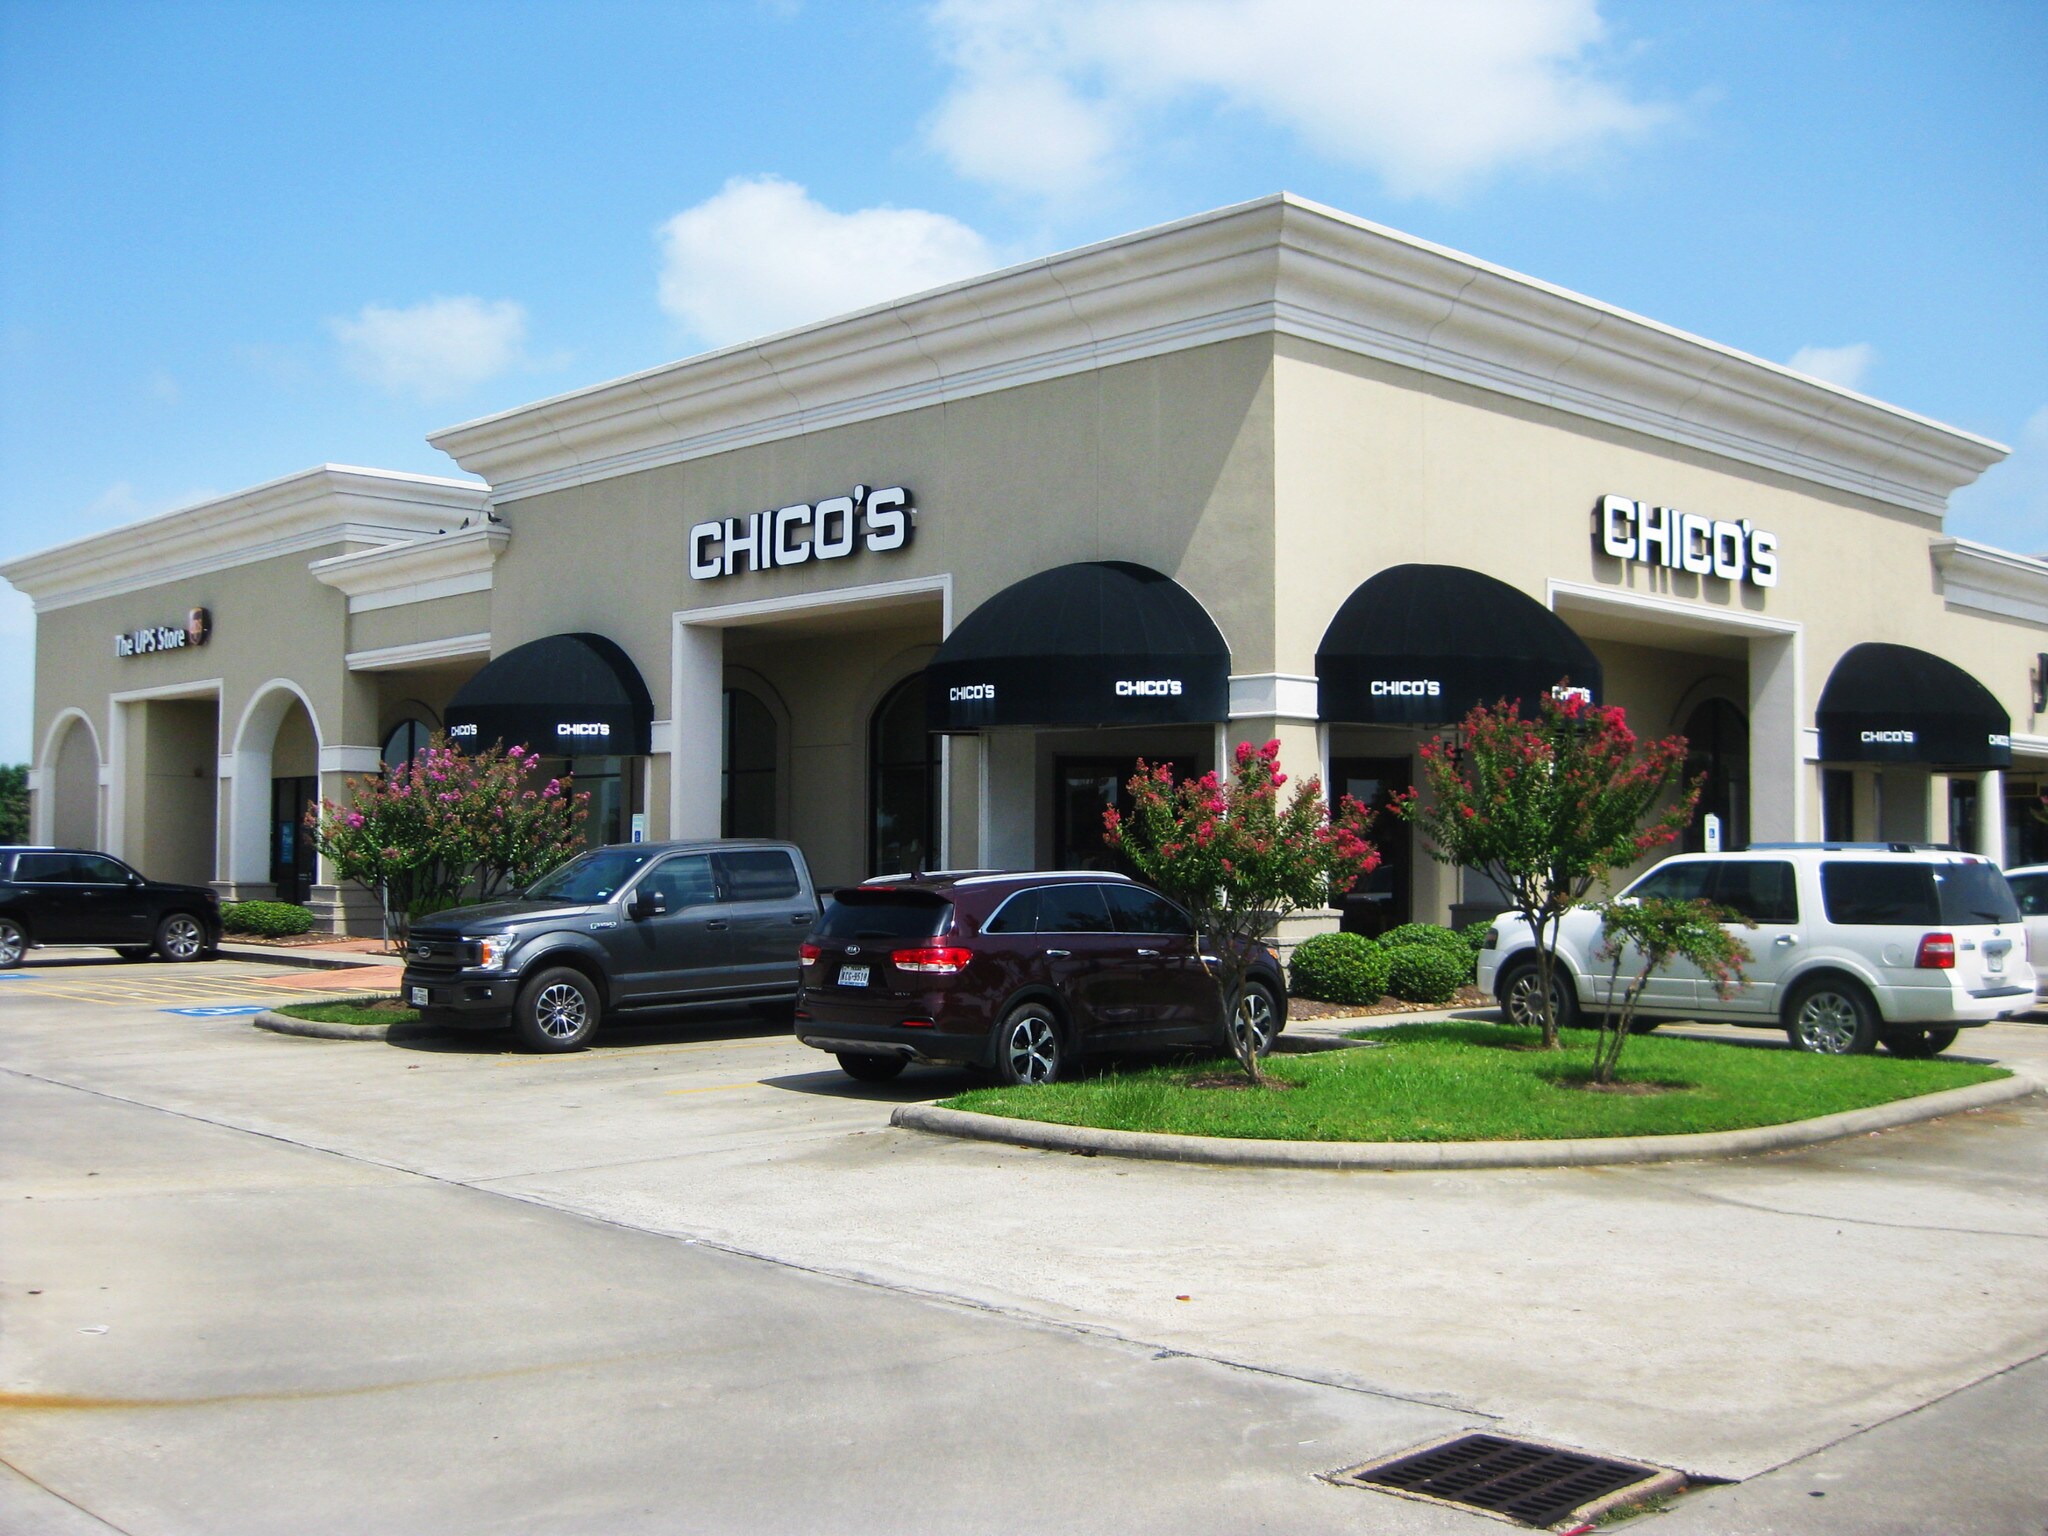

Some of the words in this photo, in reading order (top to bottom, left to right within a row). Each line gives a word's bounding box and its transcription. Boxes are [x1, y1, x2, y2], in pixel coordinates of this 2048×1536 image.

[689, 484, 905, 580] CHICO'S
[1603, 493, 1778, 588] CHICO'S
[115, 634, 133, 657] The
[134, 628, 156, 654] UPS
[157, 626, 185, 651] Store
[949, 683, 995, 701] CHICO'S
[1115, 679, 1183, 696] CHICO'S
[1370, 679, 1441, 696] CHICO'S
[450, 723, 478, 737] CHICO'S
[557, 722, 610, 736] CHICO'S
[1860, 730, 1914, 743] CHICO'S
